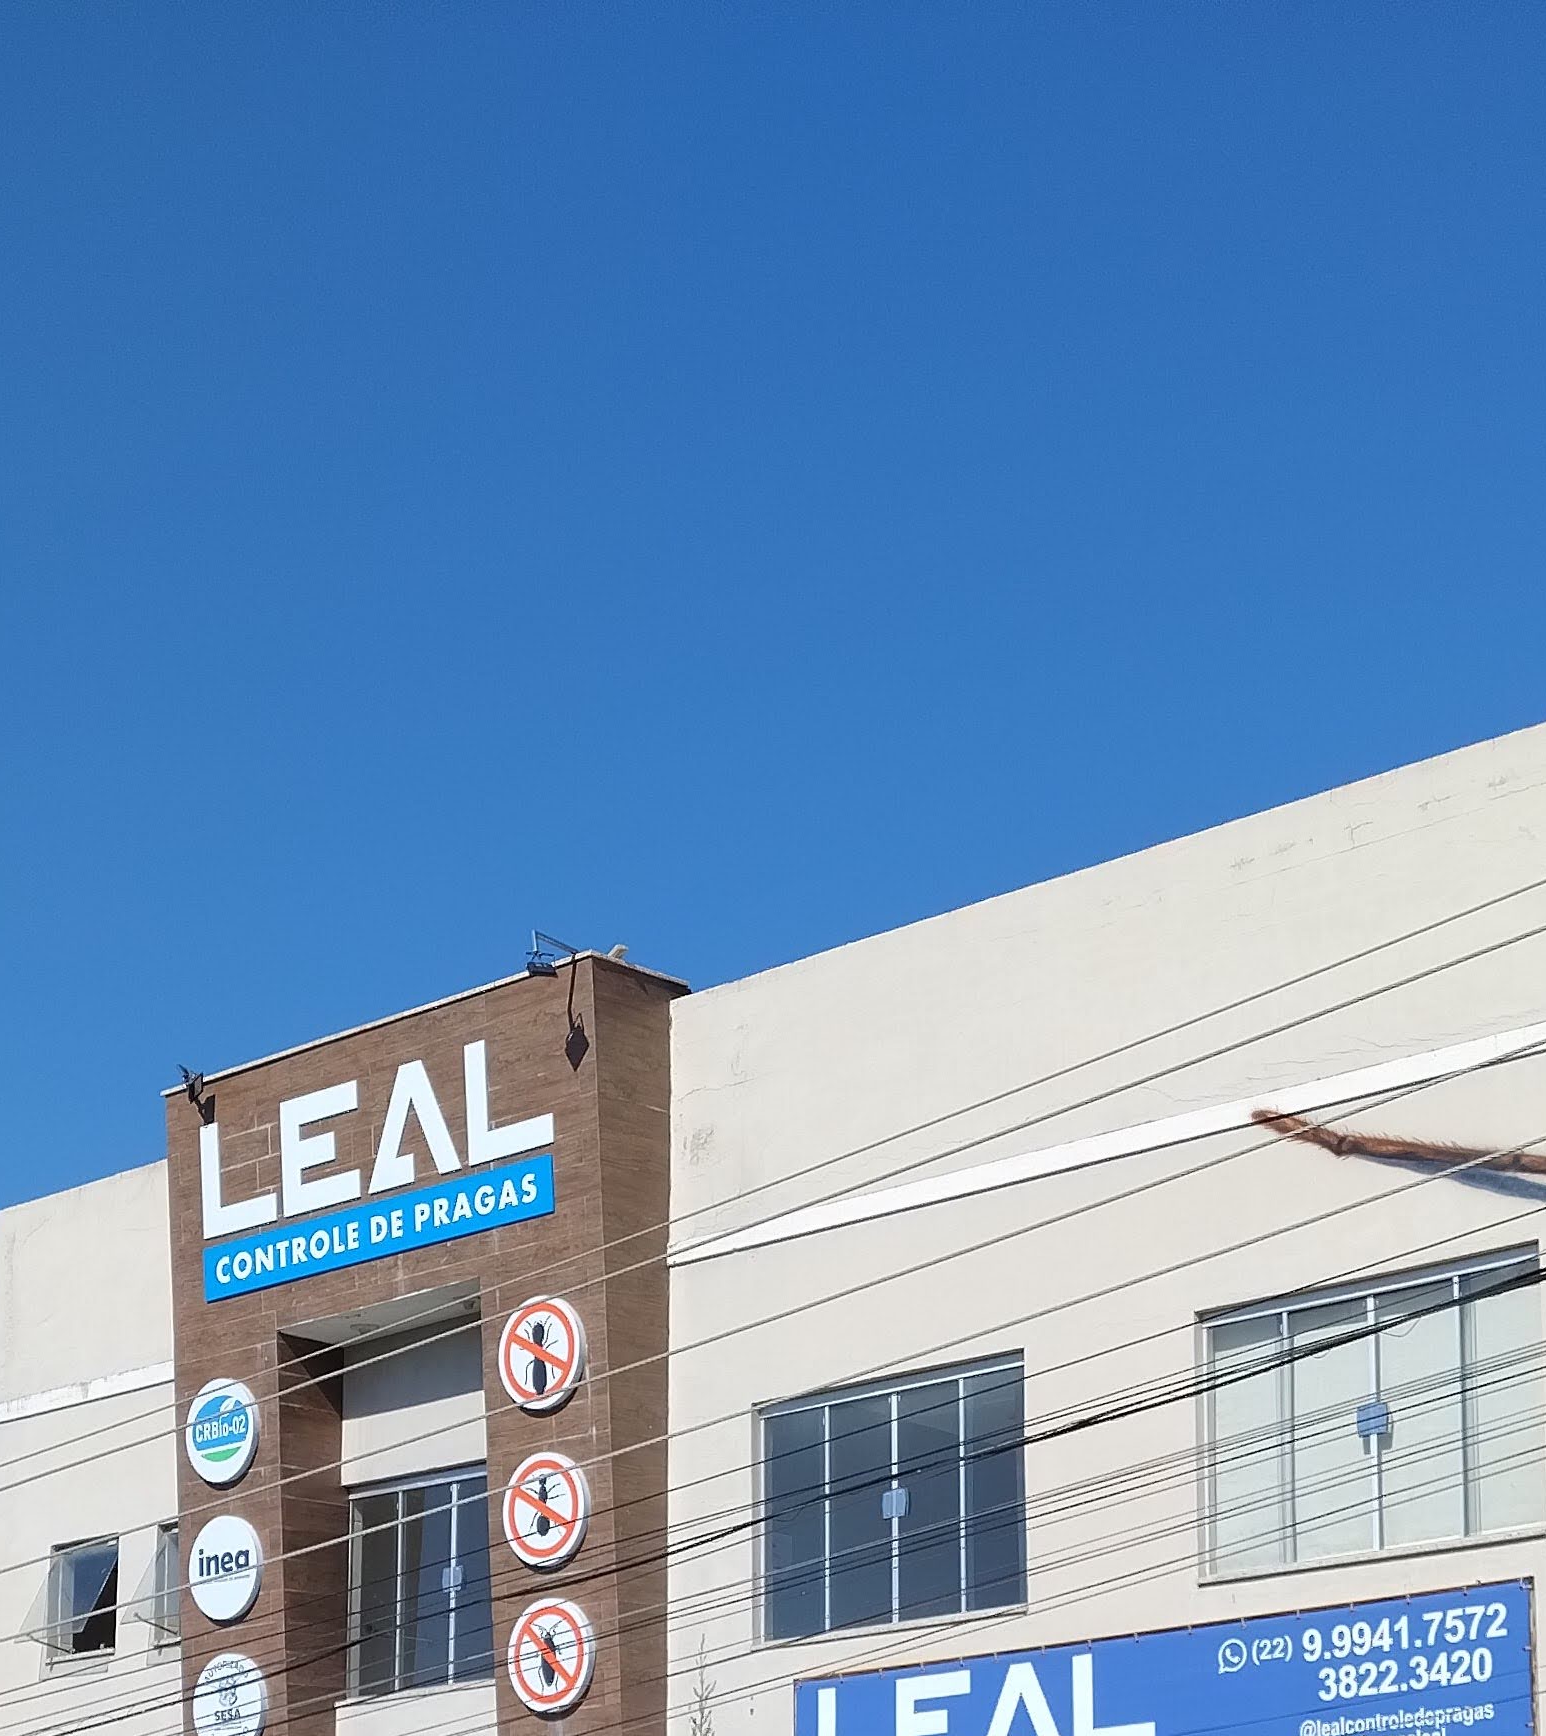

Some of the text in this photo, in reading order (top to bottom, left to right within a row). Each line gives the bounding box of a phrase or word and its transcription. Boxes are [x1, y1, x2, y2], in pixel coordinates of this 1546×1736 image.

[200, 1040, 555, 1239] LEAL
[215, 1173, 538, 1285] CONTROLE DE PRAGAS
[196, 1415, 246, 1443] CRBio-02
[198, 1549, 250, 1578] inea
[1251, 1602, 1508, 1666] (22) 9.9941.7572
[1318, 1647, 1493, 1702] 3822.3420
[214, 1708, 241, 1721] SESA
